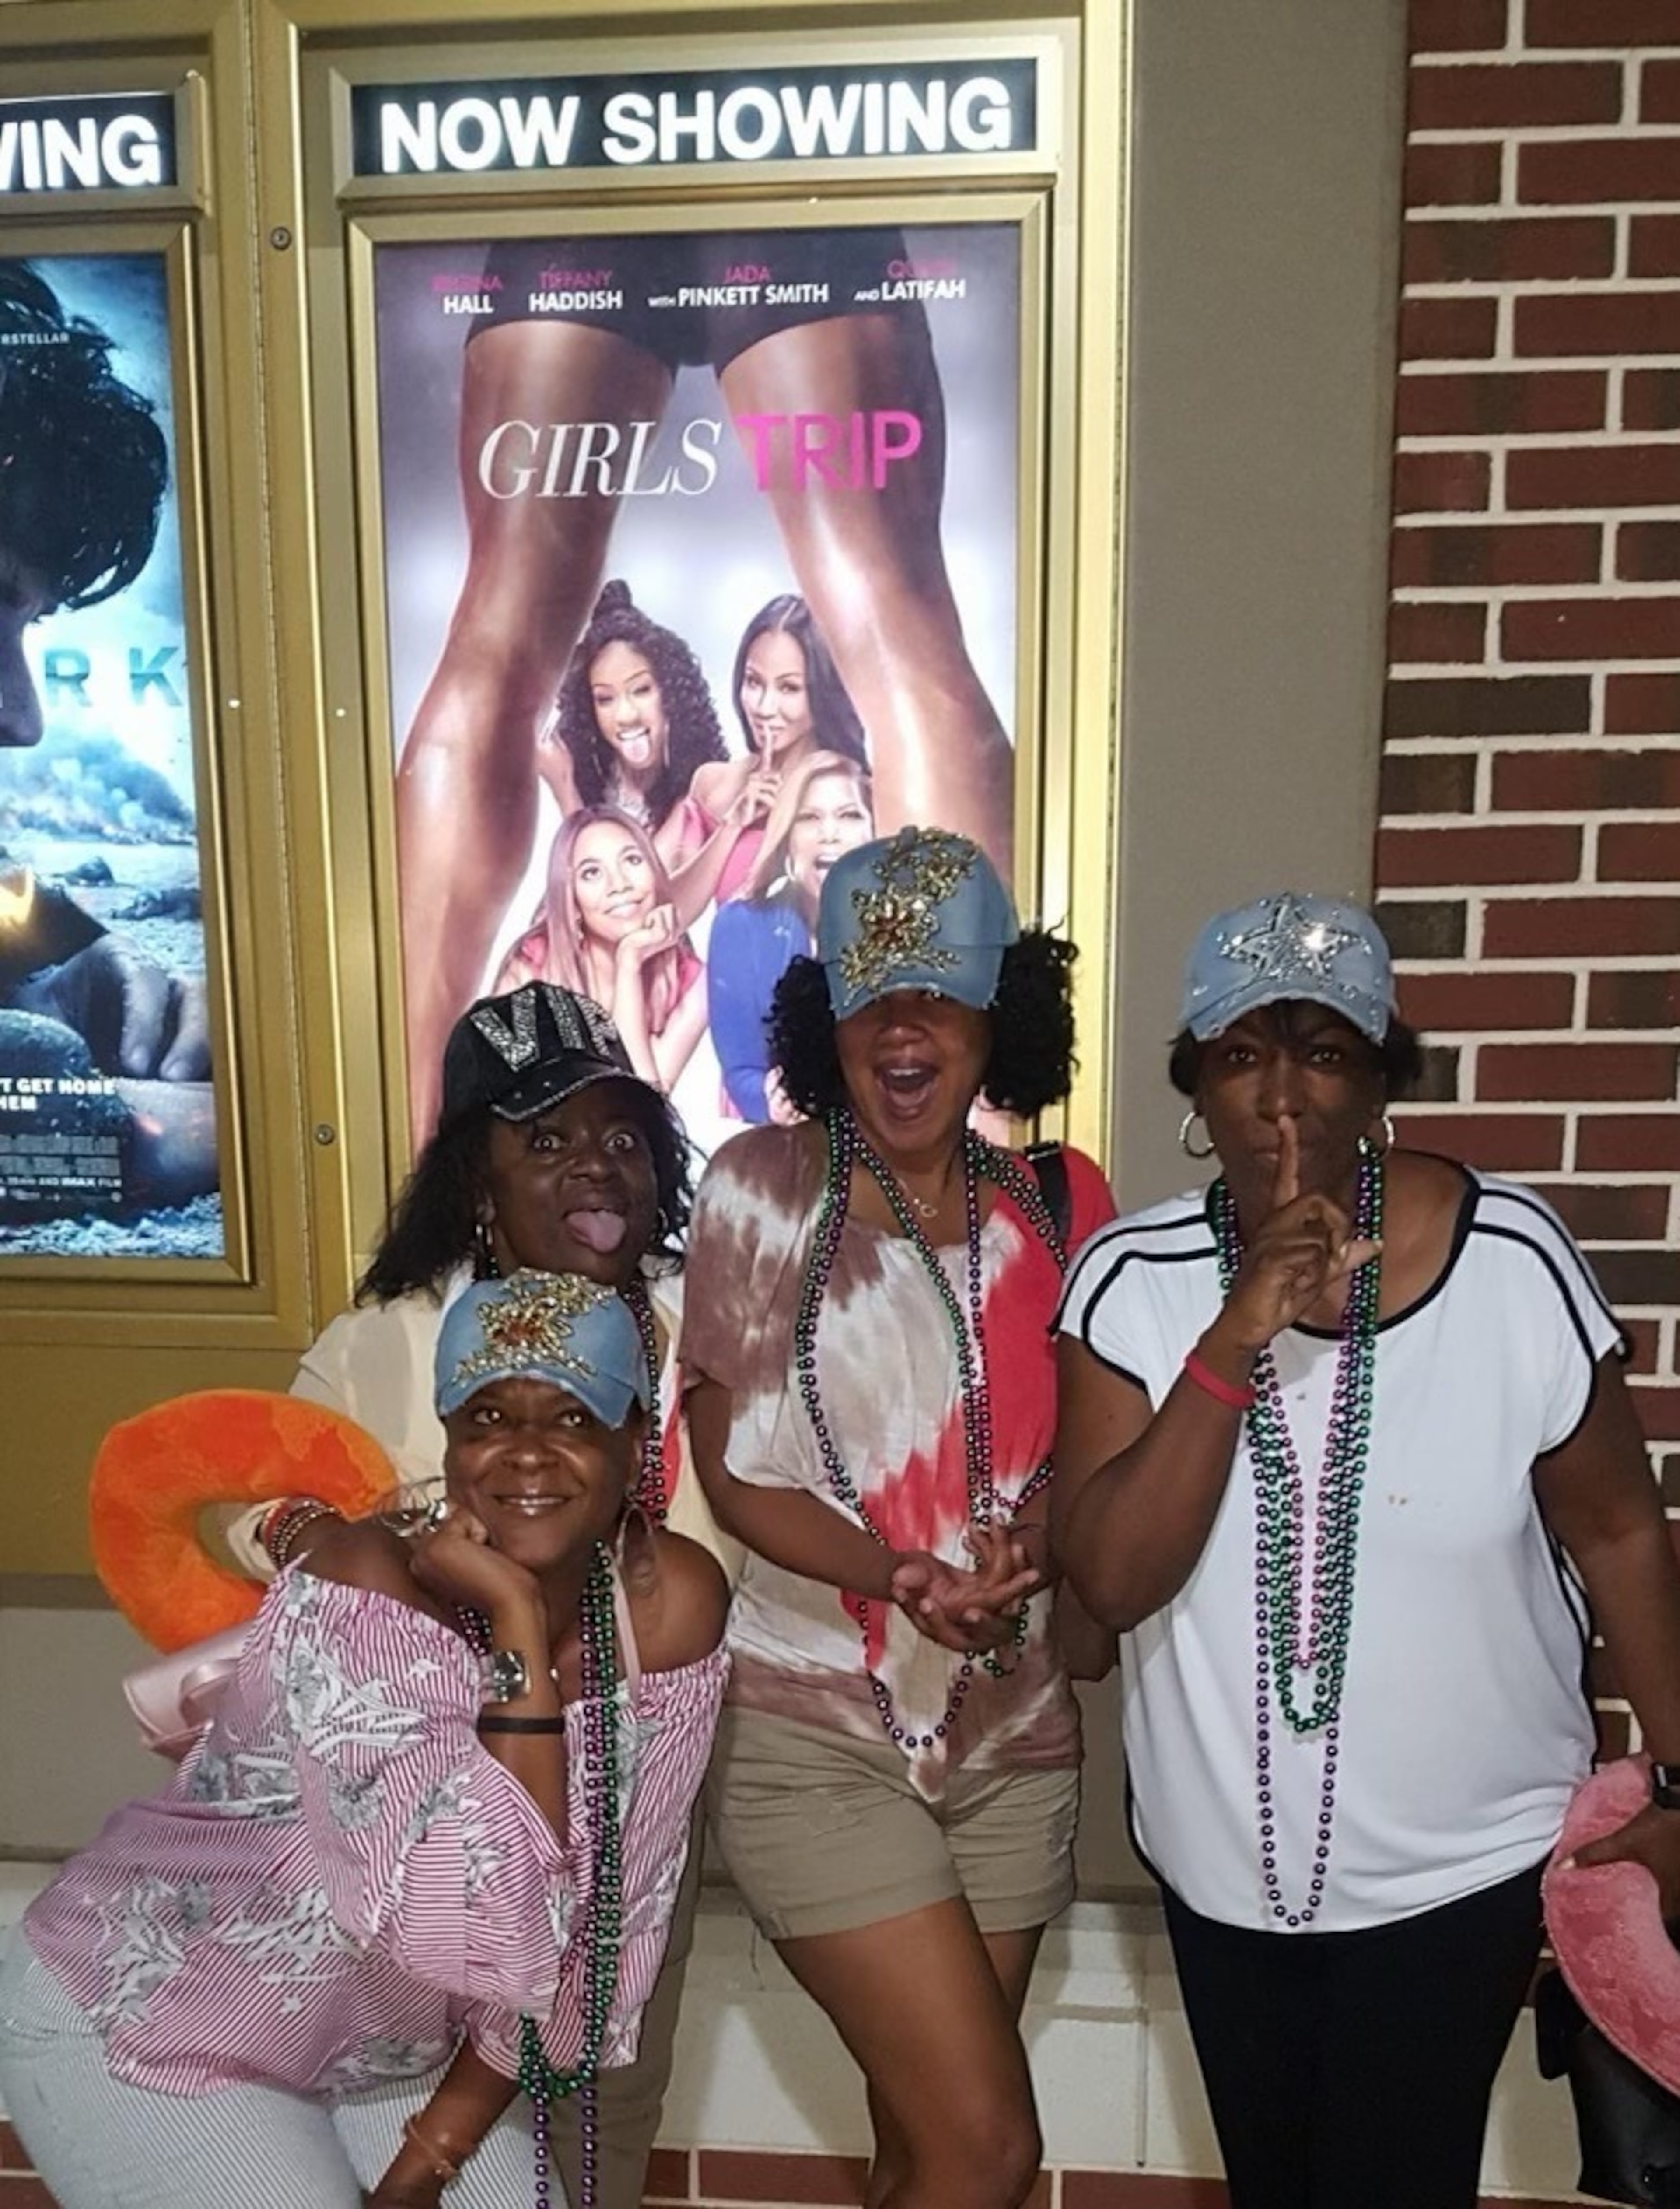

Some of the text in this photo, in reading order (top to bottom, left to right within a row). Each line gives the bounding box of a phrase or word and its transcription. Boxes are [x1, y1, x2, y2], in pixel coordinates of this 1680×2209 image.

[381, 76, 1012, 173] NOW SHOWING
[0, 114, 161, 191] ING
[723, 265, 772, 284] JADA
[528, 290, 623, 312] HADDISH
[678, 284, 761, 307] PINKETT
[765, 282, 829, 305] SMITH
[881, 278, 966, 302] LATIFAH
[443, 294, 494, 314] HALL
[478, 410, 923, 500] GIRLS TRIP
[16, 1077, 54, 1094] GET
[57, 1078, 116, 1096] HOME
